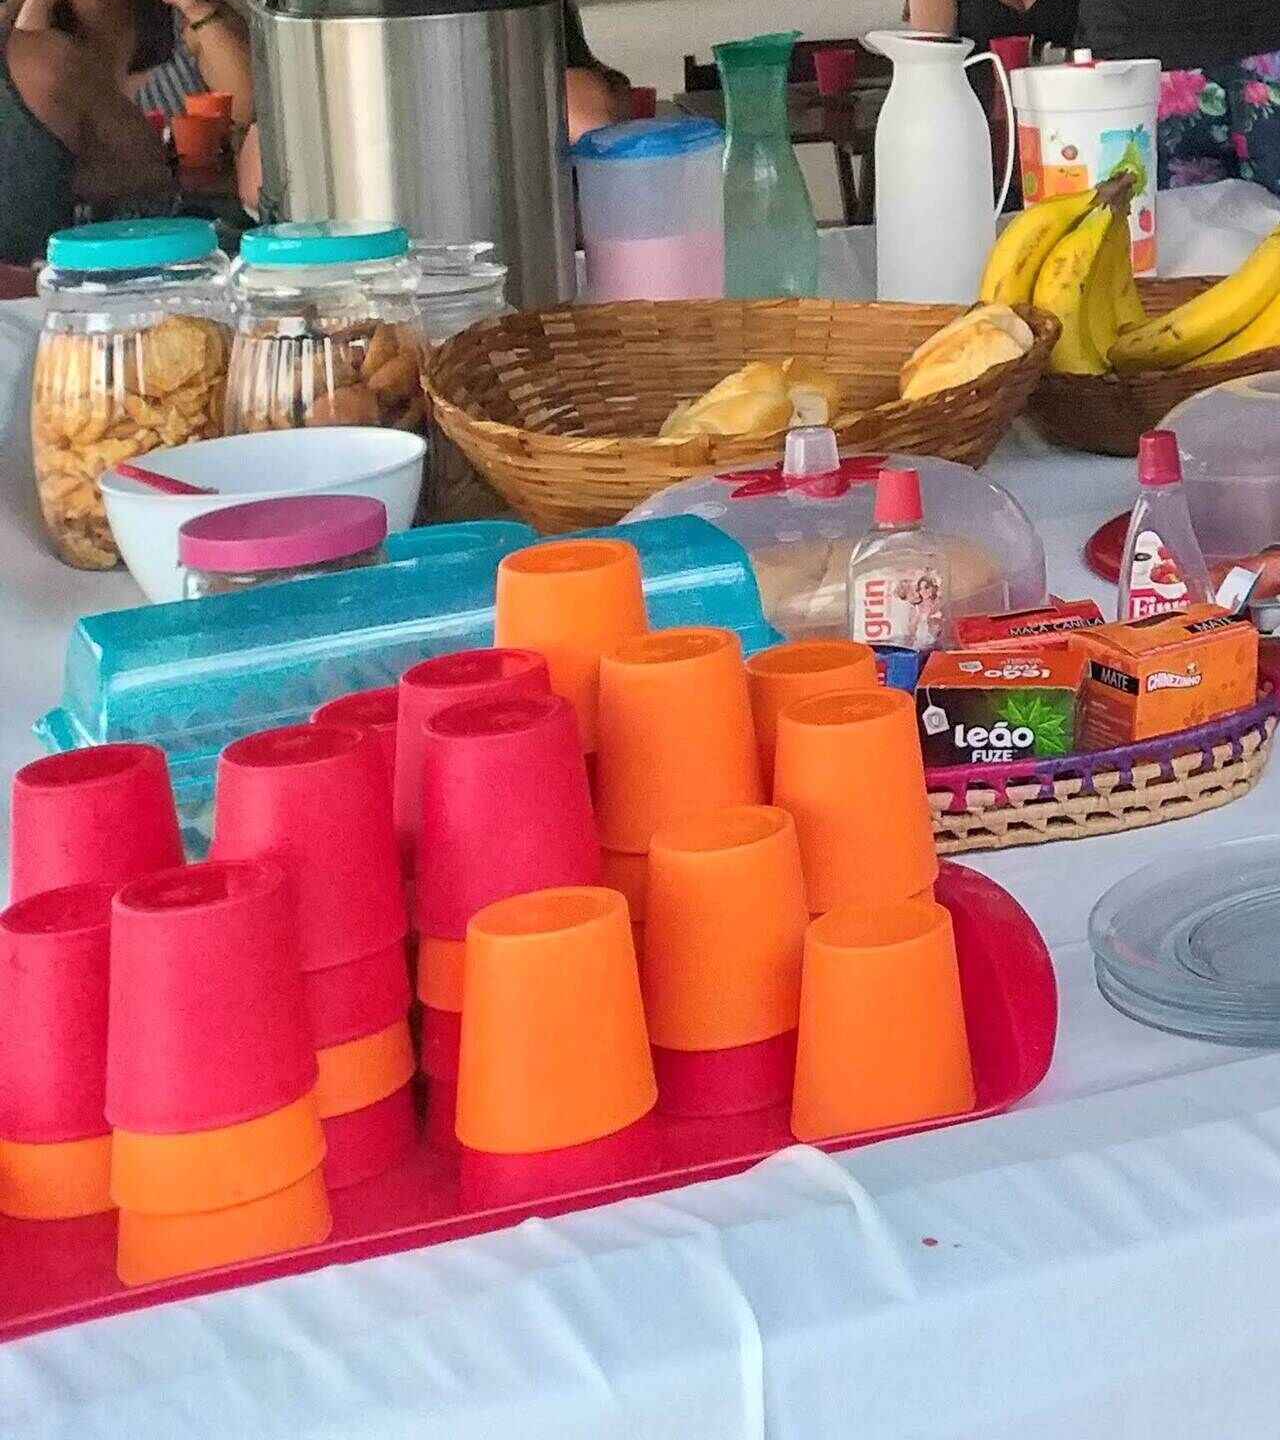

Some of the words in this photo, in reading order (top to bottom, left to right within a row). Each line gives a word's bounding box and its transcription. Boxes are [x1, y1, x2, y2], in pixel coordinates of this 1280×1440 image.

[1194, 617, 1237, 633] MATE
[1101, 666, 1130, 692] MATE
[954, 721, 1035, 748] leão
[971, 749, 1014, 763] FUZE
